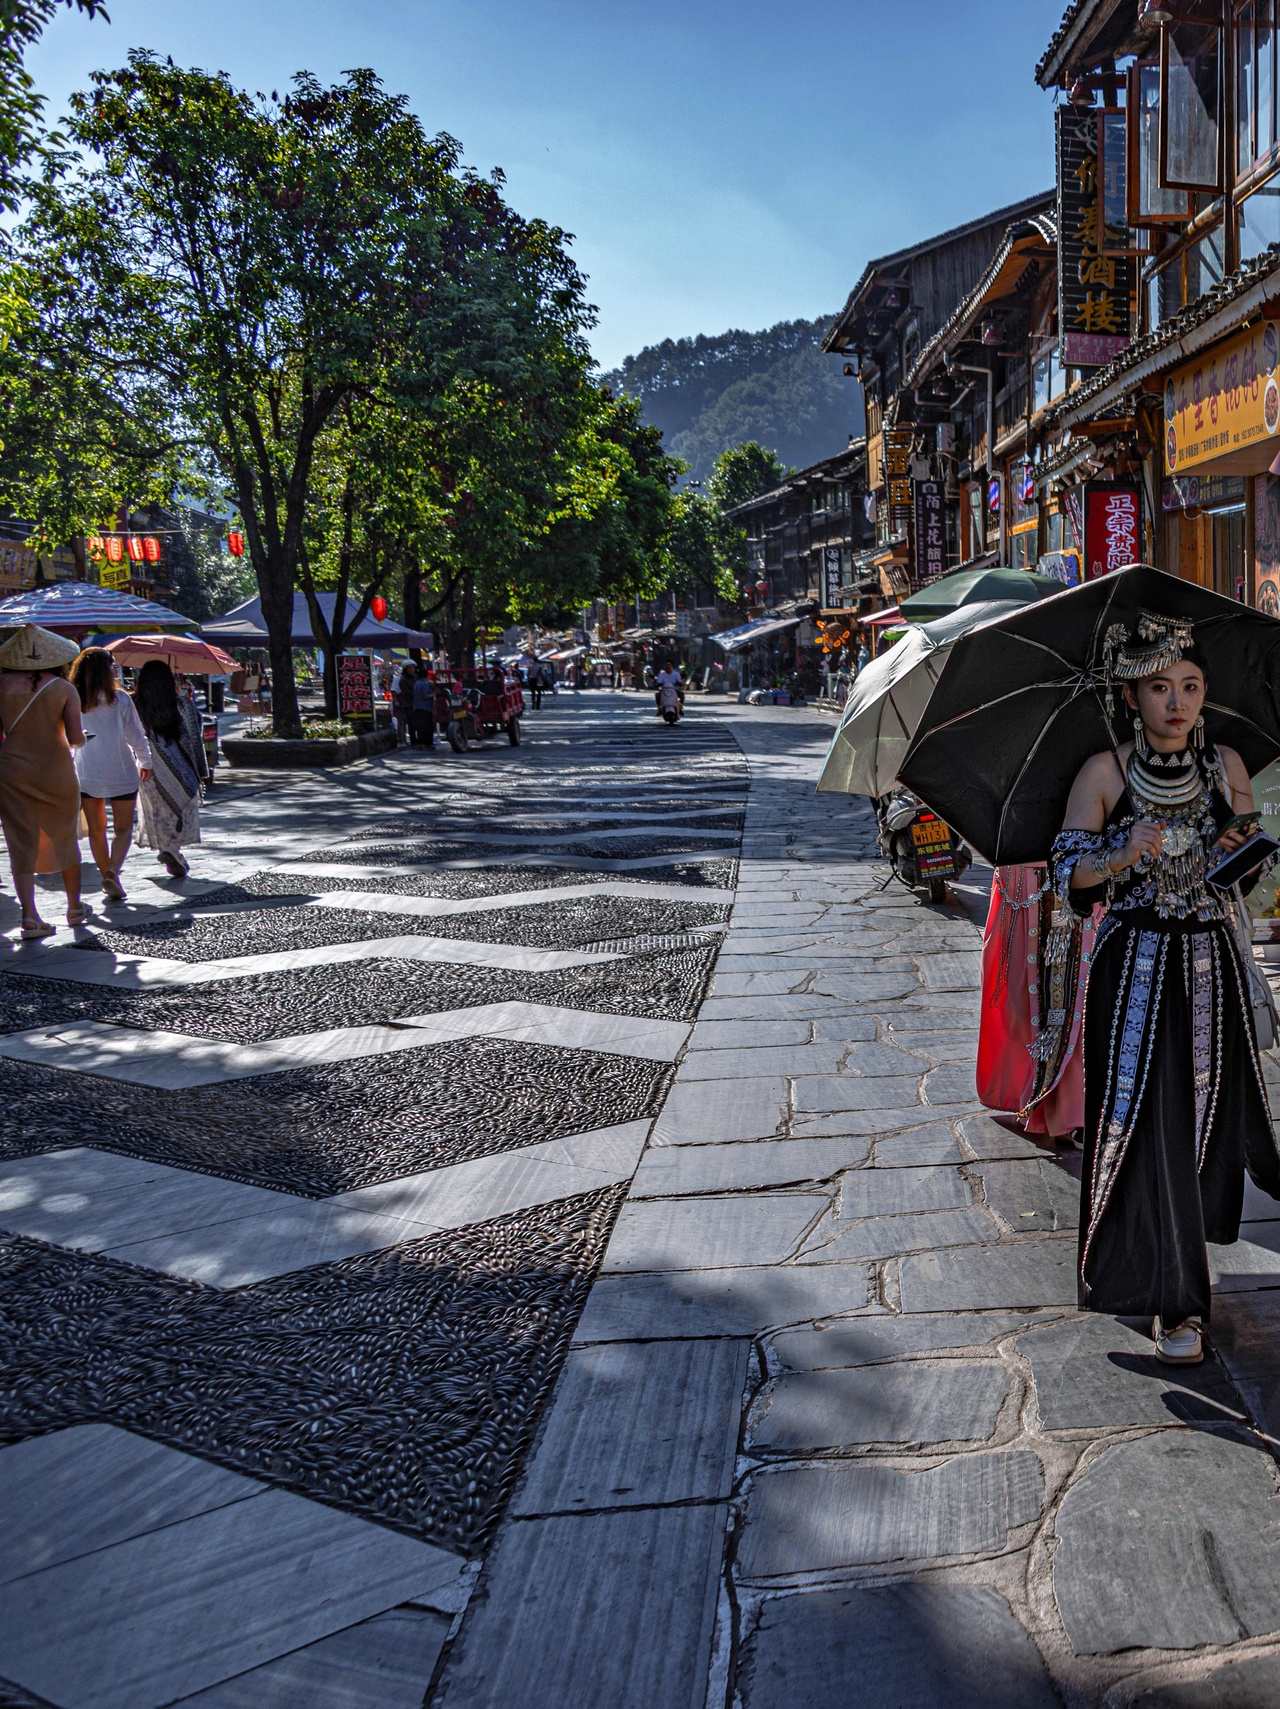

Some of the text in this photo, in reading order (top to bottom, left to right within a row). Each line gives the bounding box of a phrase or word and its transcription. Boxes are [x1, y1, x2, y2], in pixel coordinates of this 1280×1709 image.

[1176, 337, 1259, 438] 千里香馄饨
[339, 657, 371, 713] 足浴按摩
[914, 830, 947, 844] WH131
[926, 855, 953, 864] HONDA
